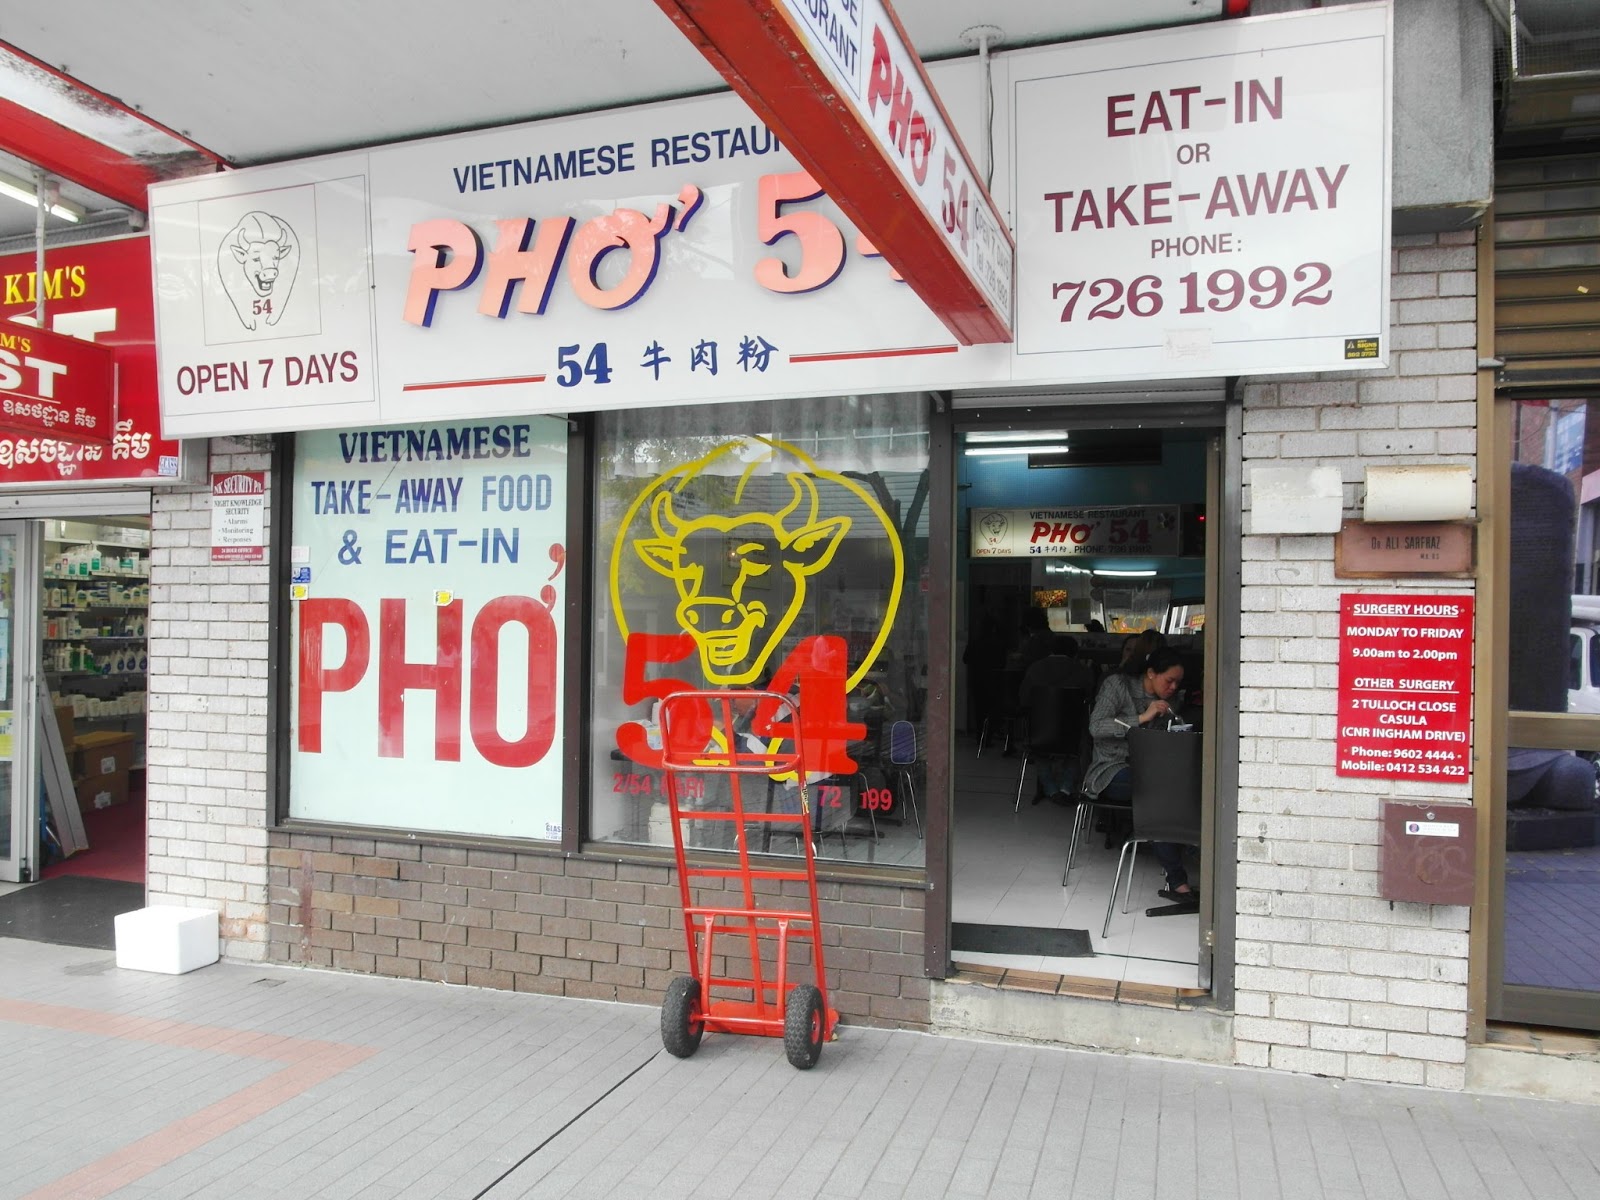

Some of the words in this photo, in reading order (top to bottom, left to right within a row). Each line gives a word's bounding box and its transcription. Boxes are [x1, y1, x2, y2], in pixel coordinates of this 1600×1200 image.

[1107, 76, 1284, 138] EAT-IN
[453, 143, 635, 194] VIETNAMESE
[651, 124, 780, 168] RESTAU
[1176, 143, 1211, 164] OR
[942, 146, 968, 257] 54
[1044, 164, 1350, 233] TAKE-AWAY
[3, 265, 86, 305] KIM'S
[1052, 275, 1164, 323] 726
[1179, 262, 1333, 315] 1992
[252, 298, 273, 316] 54
[556, 342, 613, 388] 54
[640, 335, 780, 381] 牛肉粉
[177, 360, 249, 396] OPEN
[258, 358, 274, 389] 7
[285, 350, 359, 387] DAYS
[338, 424, 531, 464] VIETNAMESE
[223, 474, 254, 494] SECURITY
[214, 500, 229, 508] NIGHT
[230, 499, 262, 508] KNOWLEDGE
[311, 477, 463, 515] TAKE-AWAY
[481, 474, 552, 512] FOOD
[225, 508, 249, 516] SECURITY
[1030, 510, 1084, 520] VIETNAMESE
[1088, 510, 1145, 519] RESTAURANT
[222, 527, 254, 535] Monitoring
[1109, 519, 1152, 544] 54
[338, 529, 362, 565] &
[385, 527, 520, 564] EAT-IN
[1029, 546, 1042, 554] 54
[1386, 537, 1399, 549] ALI
[1405, 536, 1440, 549] SARFRAZ
[1353, 603, 1411, 615] SURGERY
[1413, 604, 1459, 616] HOURS
[1347, 626, 1400, 638] MONDAY
[1401, 628, 1418, 638] TO
[1420, 628, 1464, 639] FRIDAY
[1352, 647, 1396, 659] 9.00am
[1397, 649, 1411, 659] to
[1412, 649, 1458, 662] 2.00pm
[1354, 678, 1394, 689] OTHER
[1399, 679, 1455, 691] SURGERY
[616, 633, 867, 775] 54
[1352, 699, 1359, 708] 2
[1360, 699, 1416, 711] TULLOCH
[1418, 701, 1457, 712] CLOSE
[1379, 714, 1427, 726] CASULA
[1342, 726, 1370, 739] (CNR
[1372, 727, 1423, 740] INGHAM
[1425, 729, 1466, 742] DRIVE)
[1351, 746, 1392, 758] Phone:
[1394, 748, 1423, 759] 9602
[1425, 750, 1455, 760] 4444
[1341, 759, 1385, 771] Mobile:
[1386, 762, 1416, 773] 0412
[1418, 764, 1440, 774] 534
[1442, 765, 1465, 775] 422
[613, 772, 651, 796] 2/54
[859, 788, 893, 811] 199
